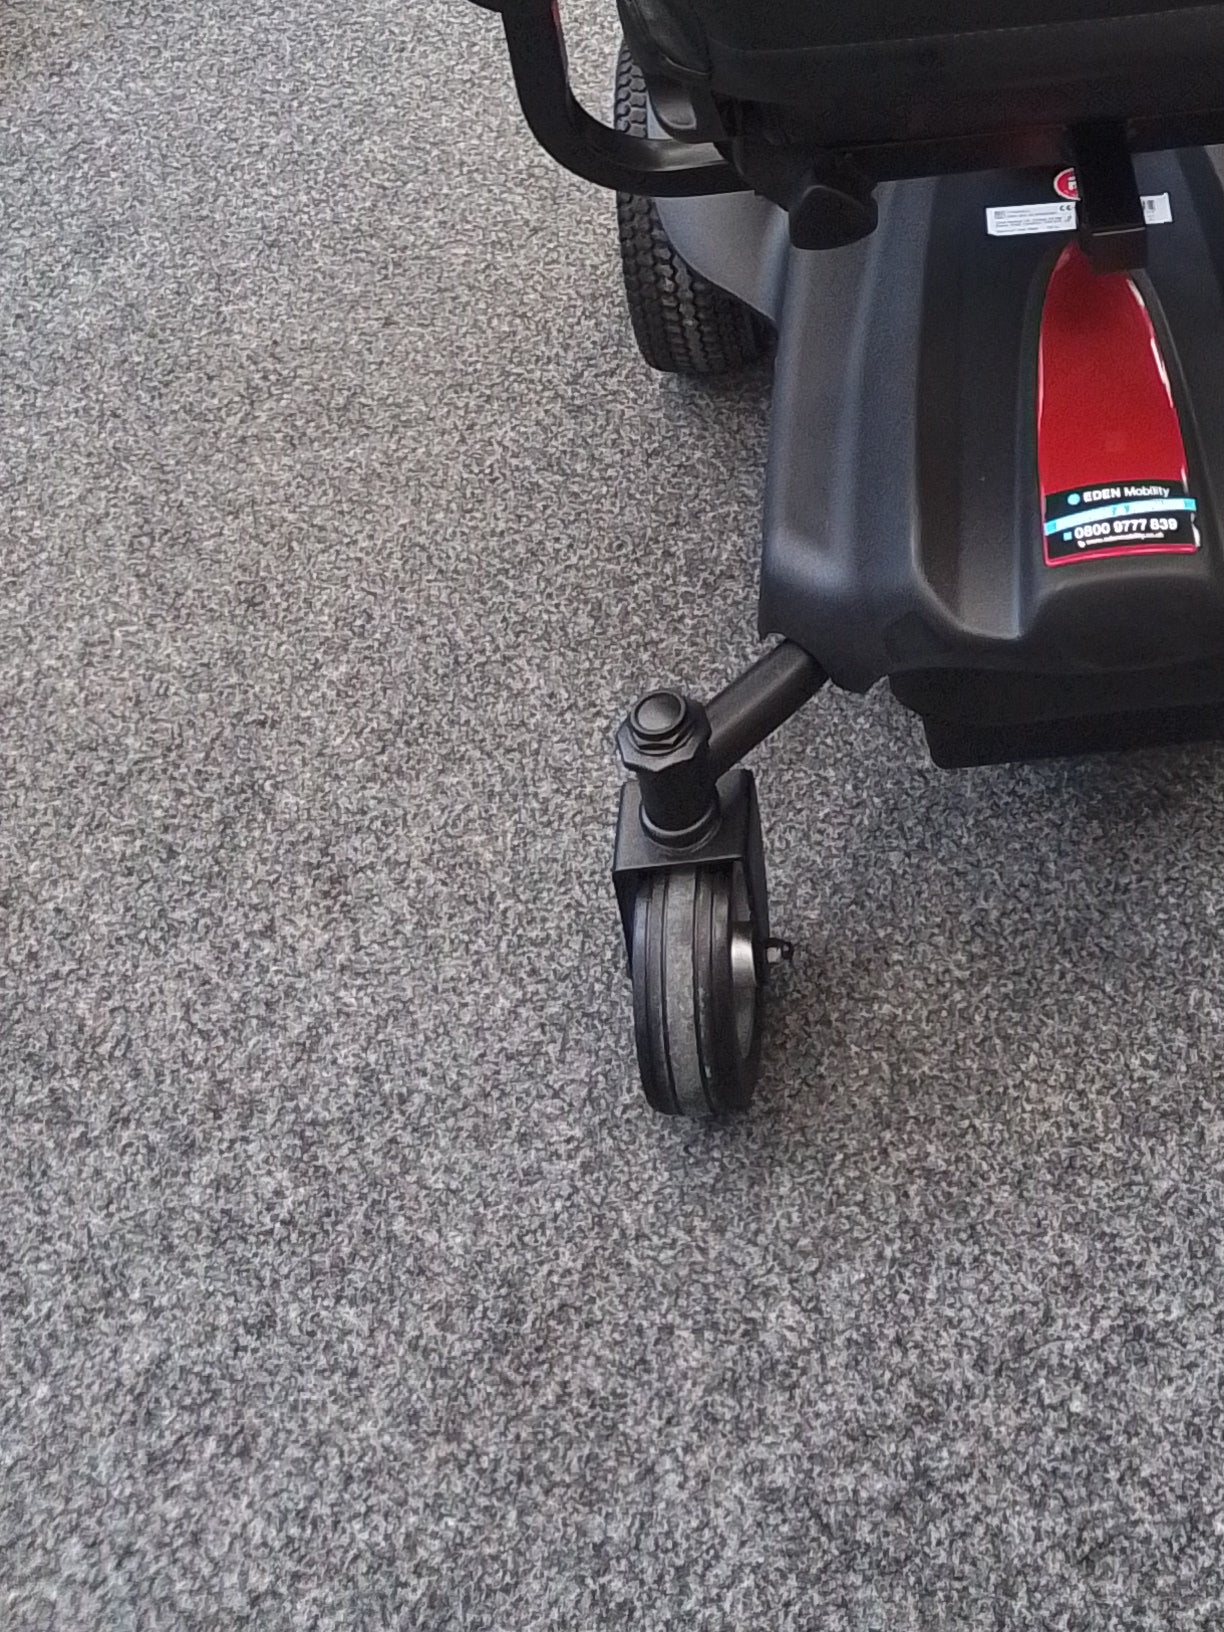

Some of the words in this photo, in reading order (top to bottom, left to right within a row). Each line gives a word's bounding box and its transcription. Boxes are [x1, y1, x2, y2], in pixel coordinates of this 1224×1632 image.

[1082, 487, 1121, 503] EDEN
[1123, 485, 1170, 498] Mobility
[1074, 522, 1111, 539] 0800
[1113, 518, 1147, 533] 9777
